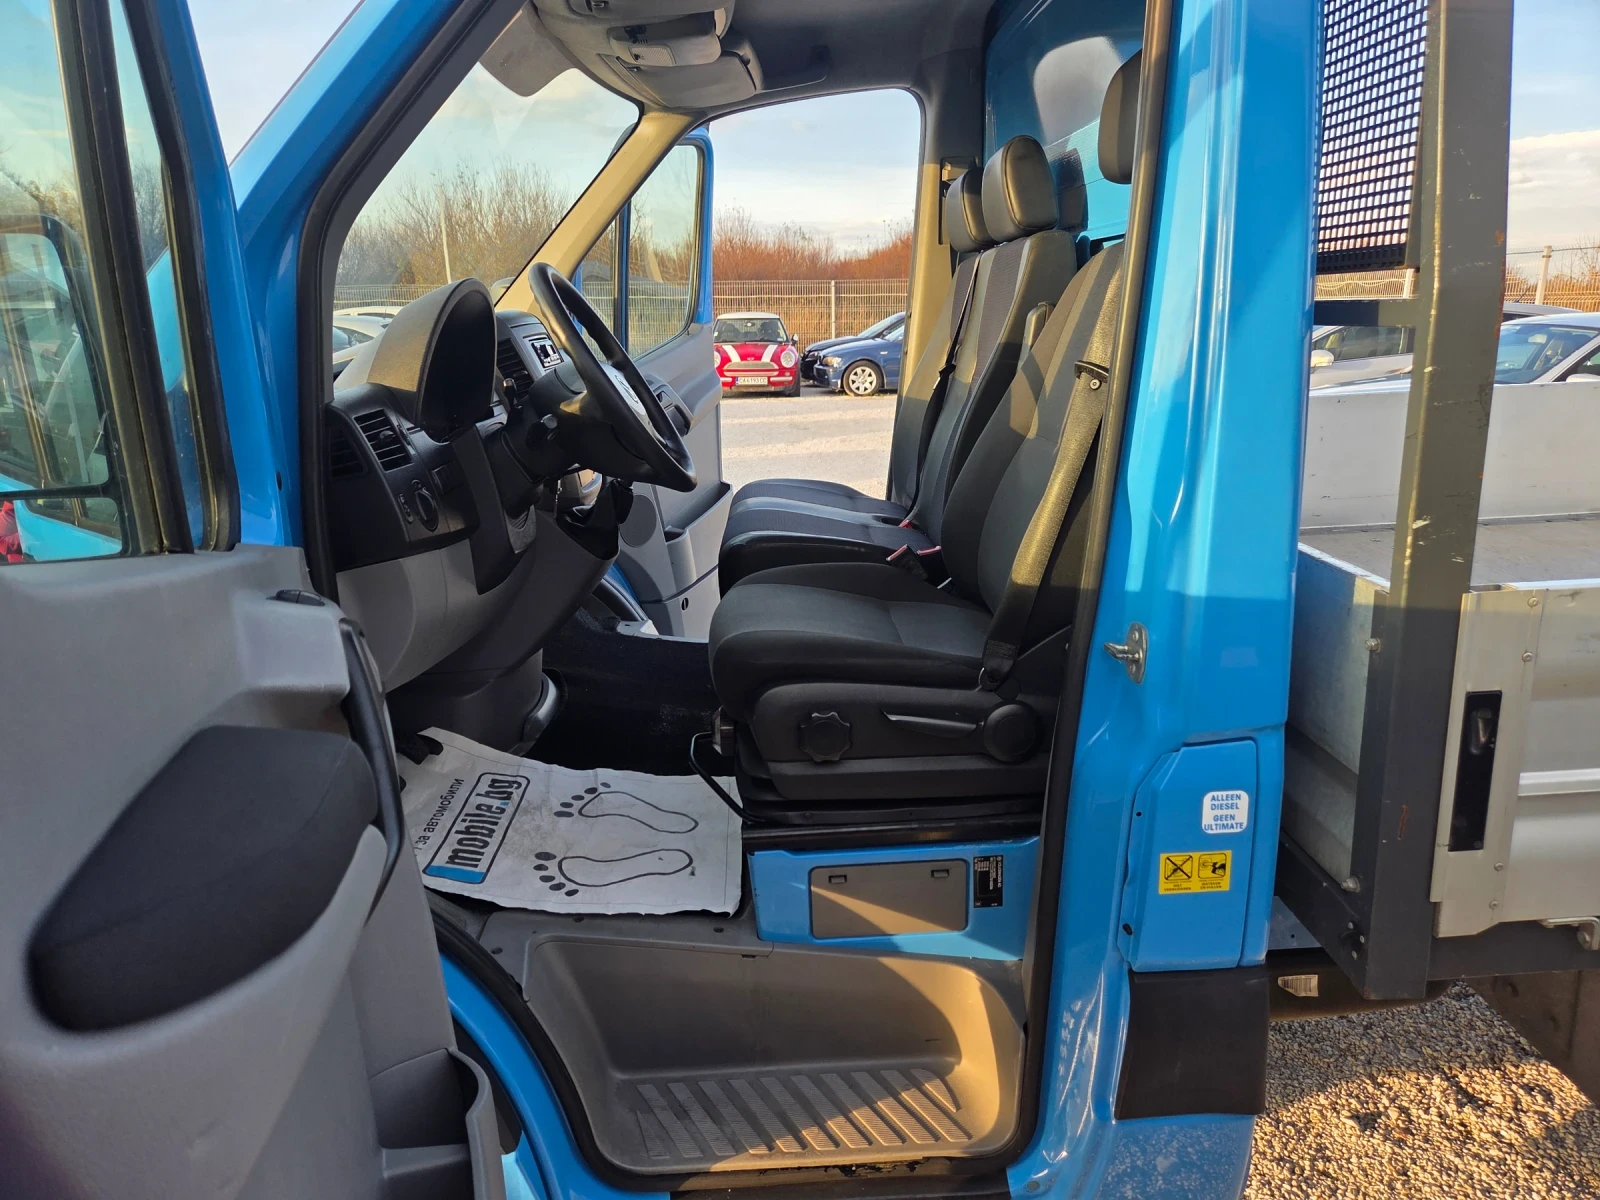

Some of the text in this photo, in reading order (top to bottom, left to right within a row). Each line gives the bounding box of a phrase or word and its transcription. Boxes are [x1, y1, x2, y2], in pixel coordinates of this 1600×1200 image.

[1210, 794, 1241, 802] ALLEEN
[1210, 802, 1240, 811] DIESEL
[415, 778, 465, 846] за автомобили
[1213, 814, 1236, 822] GEEN
[445, 778, 523, 868] mobile.bg
[1204, 822, 1244, 831] ULTIMATE
